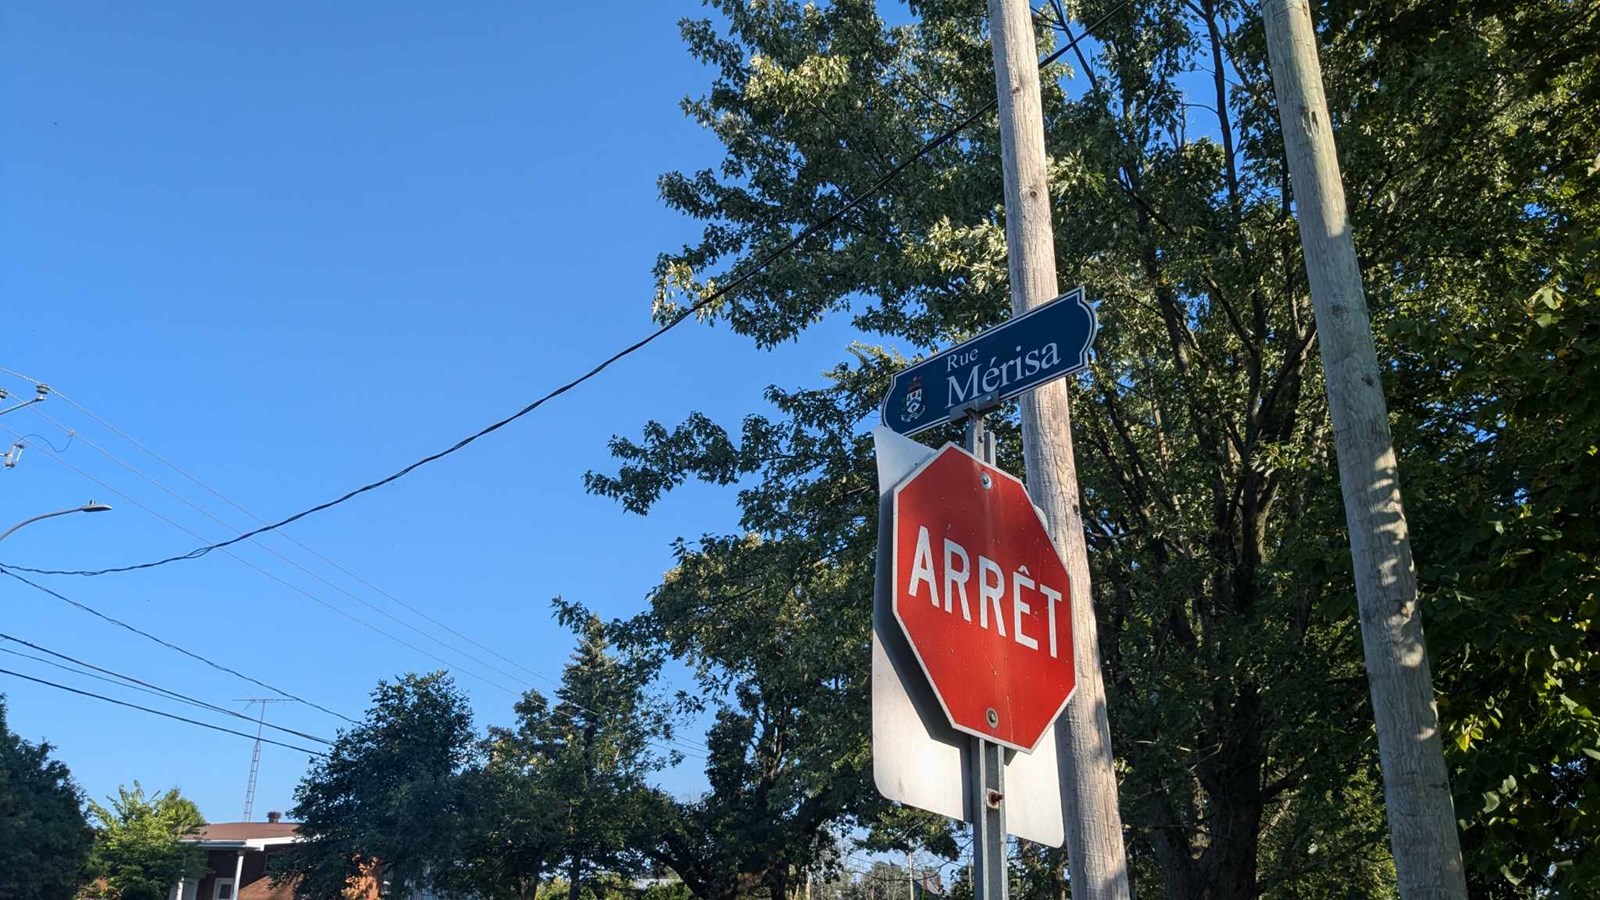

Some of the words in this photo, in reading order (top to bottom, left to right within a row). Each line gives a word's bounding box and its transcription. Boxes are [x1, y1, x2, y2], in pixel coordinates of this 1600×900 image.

[944, 342, 1062, 408] Mérisa
[946, 348, 979, 372] Rue
[908, 525, 1062, 659] ARRÊT
